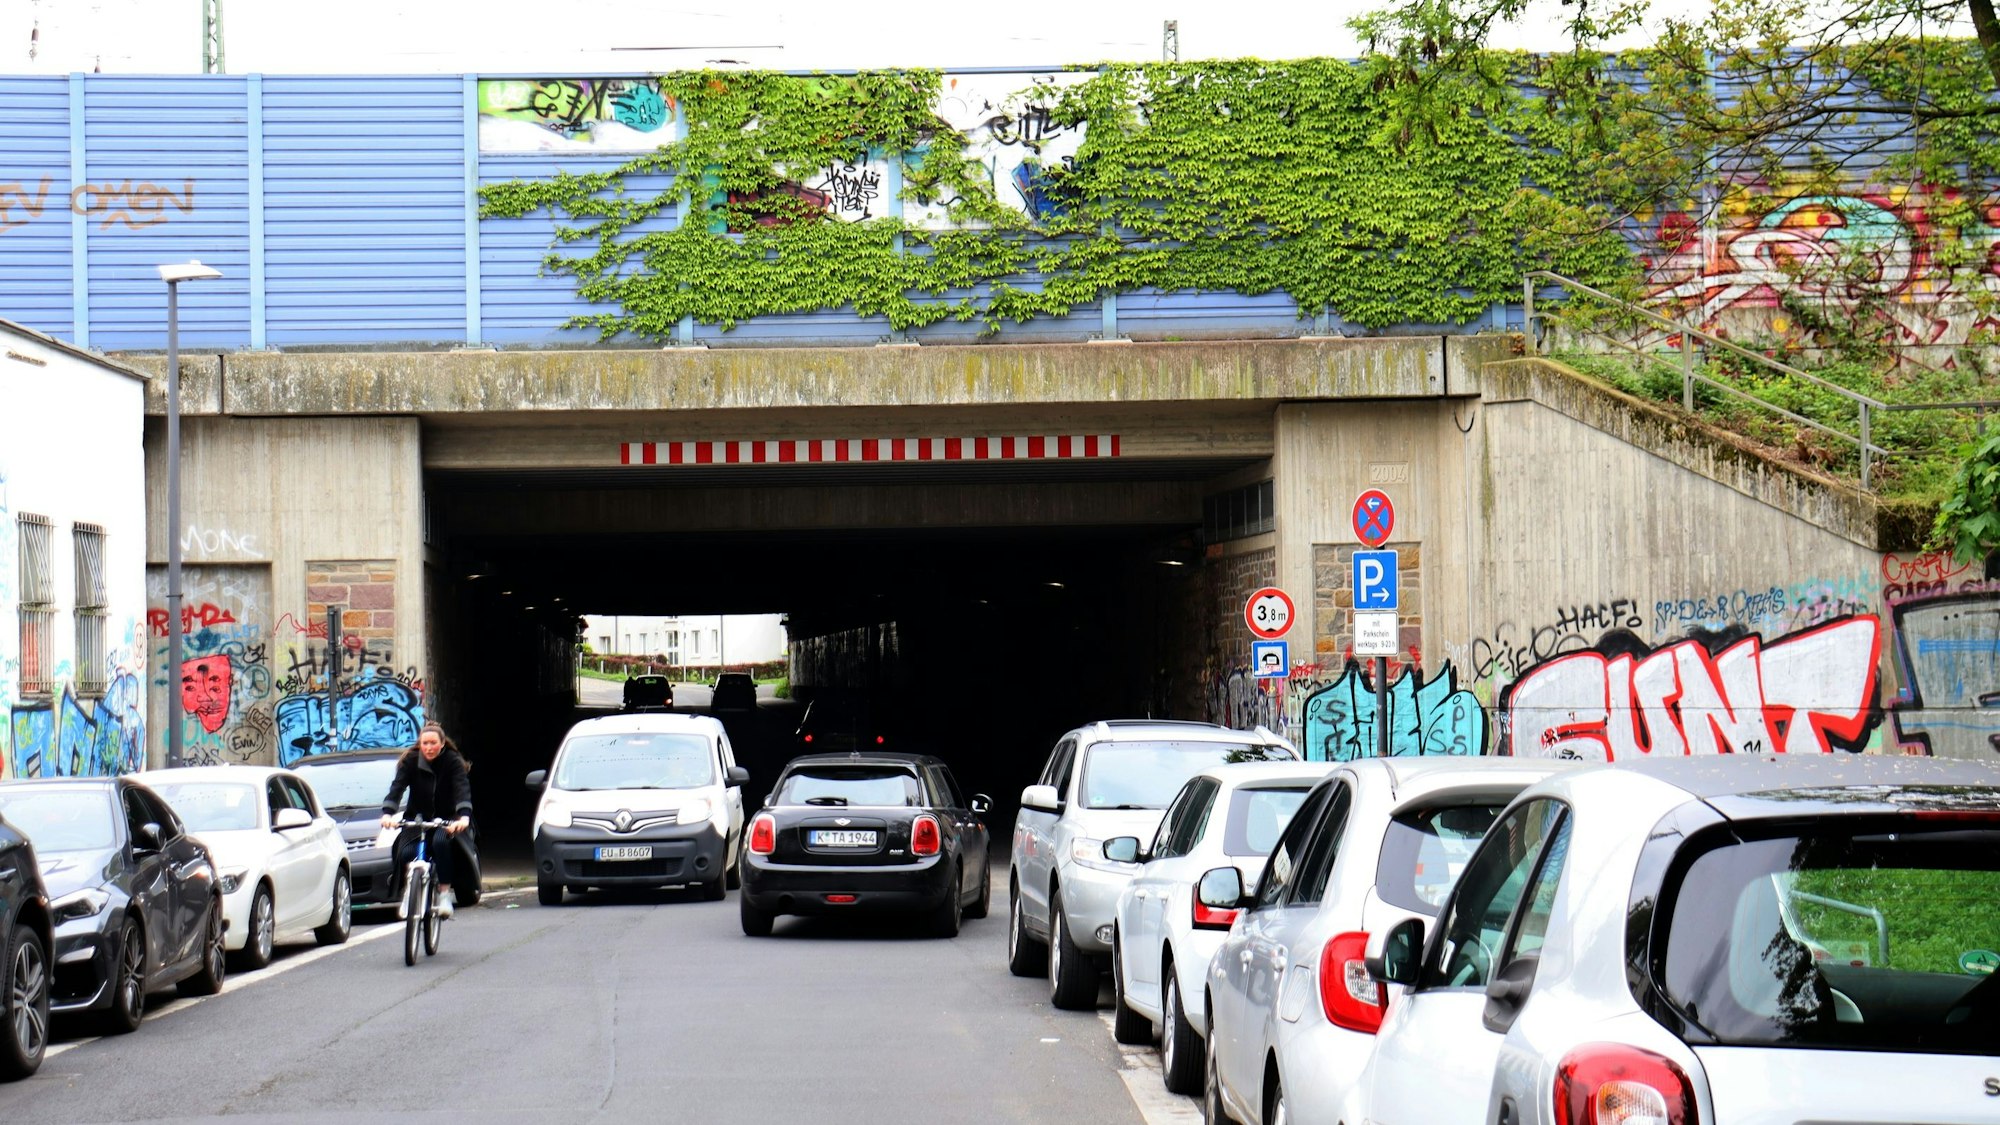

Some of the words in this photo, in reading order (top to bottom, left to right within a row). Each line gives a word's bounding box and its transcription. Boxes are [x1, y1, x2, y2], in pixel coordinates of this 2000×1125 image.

[1371, 465, 1407, 482] 2004
[1360, 558, 1384, 602] P
[1363, 630, 1389, 638] Parkschein
[1357, 641, 1377, 649] werktags
[817, 832, 824, 843] K
[832, 832, 845, 843] TA
[848, 832, 875, 843] 1944
[601, 848, 613, 857] EU
[627, 847, 651, 857] 8607
